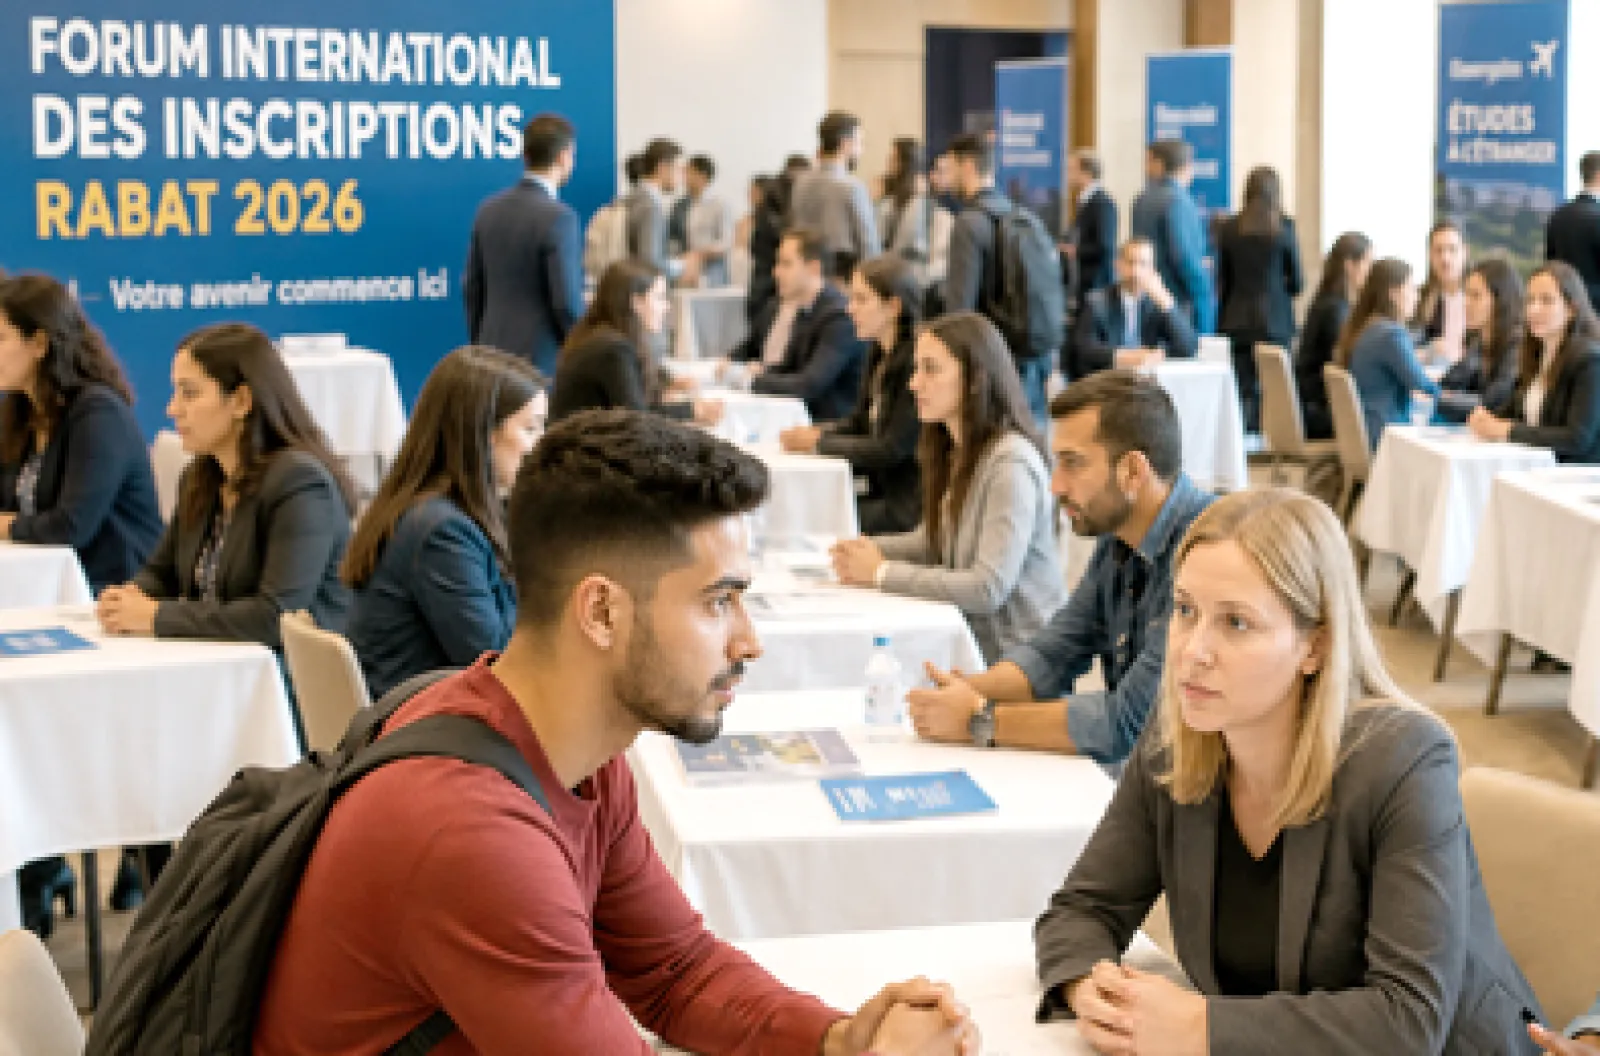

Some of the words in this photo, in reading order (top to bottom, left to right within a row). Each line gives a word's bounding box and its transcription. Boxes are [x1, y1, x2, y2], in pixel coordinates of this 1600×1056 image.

[30, 16, 208, 78] FORUM
[221, 24, 561, 88] INTERNATIONAL
[32, 95, 146, 159] DES
[162, 98, 524, 160] INSCRIPTIONS
[36, 178, 219, 239] RABAT
[234, 178, 364, 236] 2026
[109, 277, 184, 310] Votre
[191, 273, 272, 308] avenir
[276, 276, 414, 304] commence
